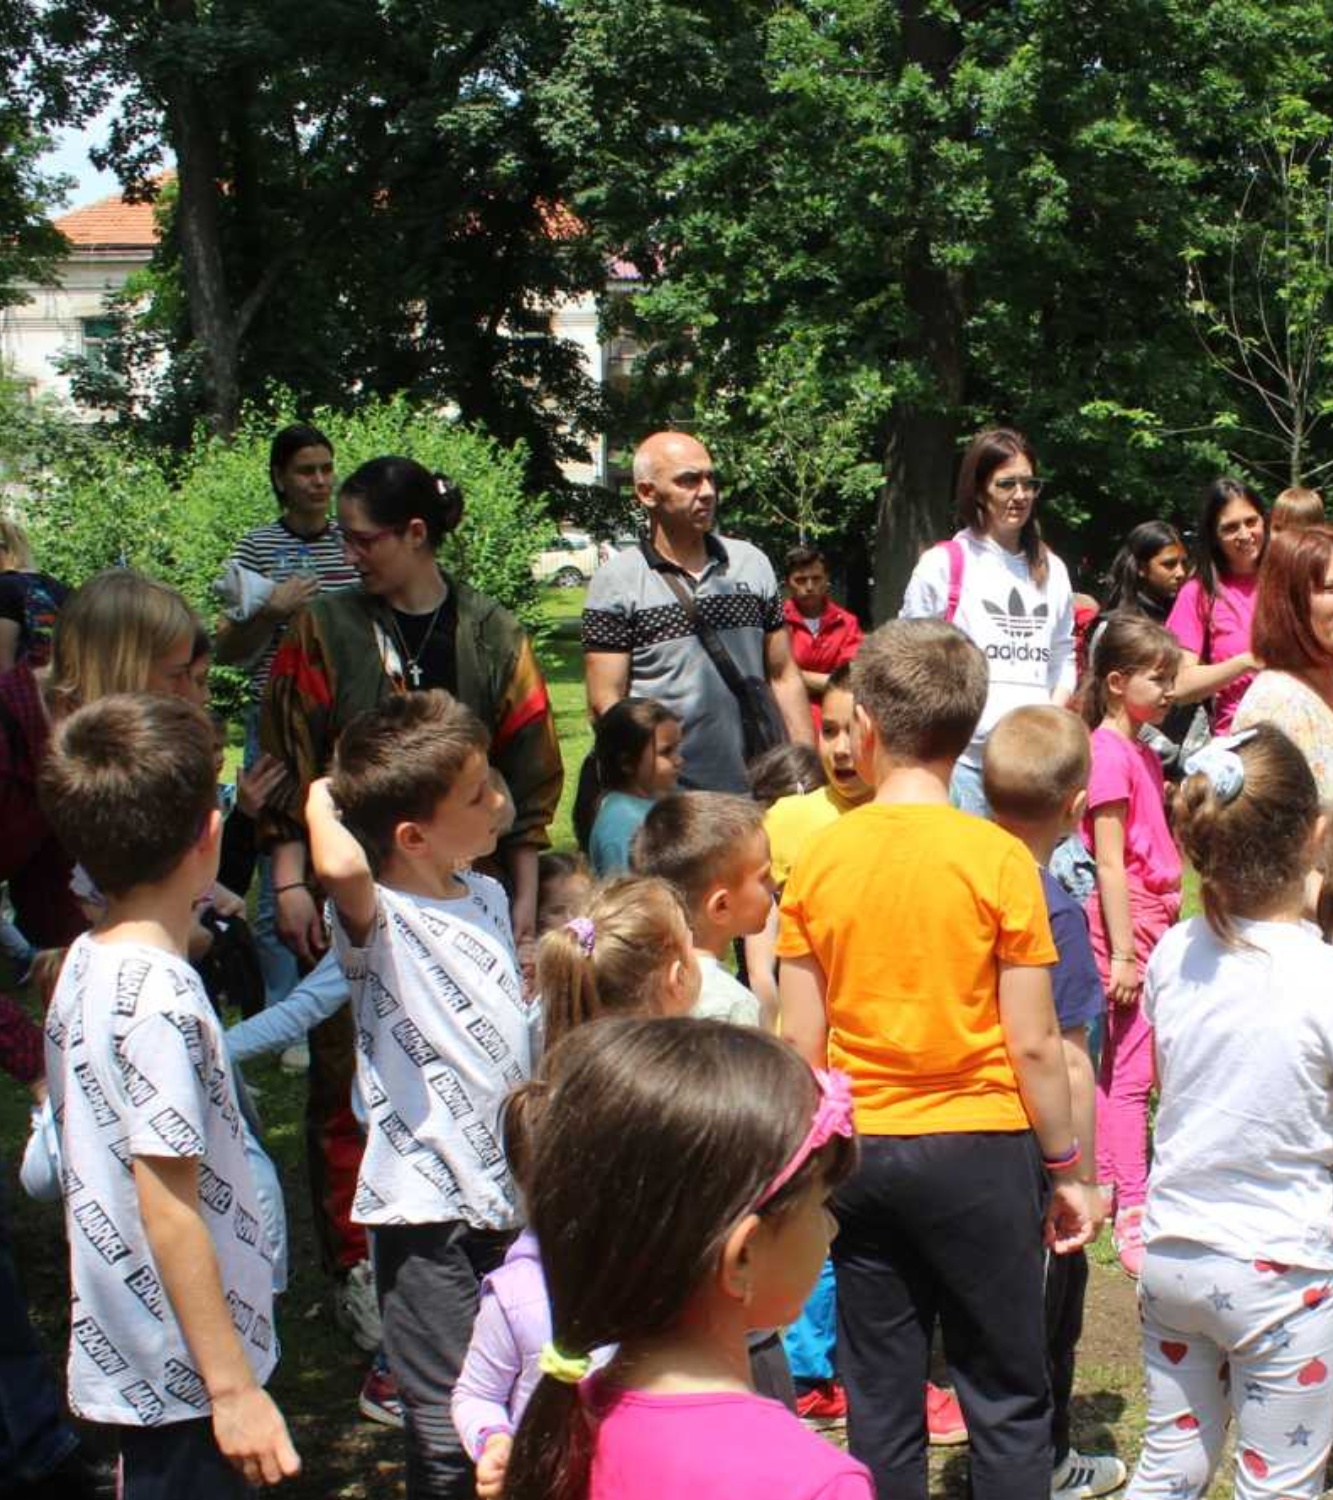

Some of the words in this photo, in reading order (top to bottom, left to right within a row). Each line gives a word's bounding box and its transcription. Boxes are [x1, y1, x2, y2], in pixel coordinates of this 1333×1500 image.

[985, 641, 1052, 663] adidas
[74, 1200, 132, 1265] MARVEL
[73, 1316, 129, 1376] MARVEL
